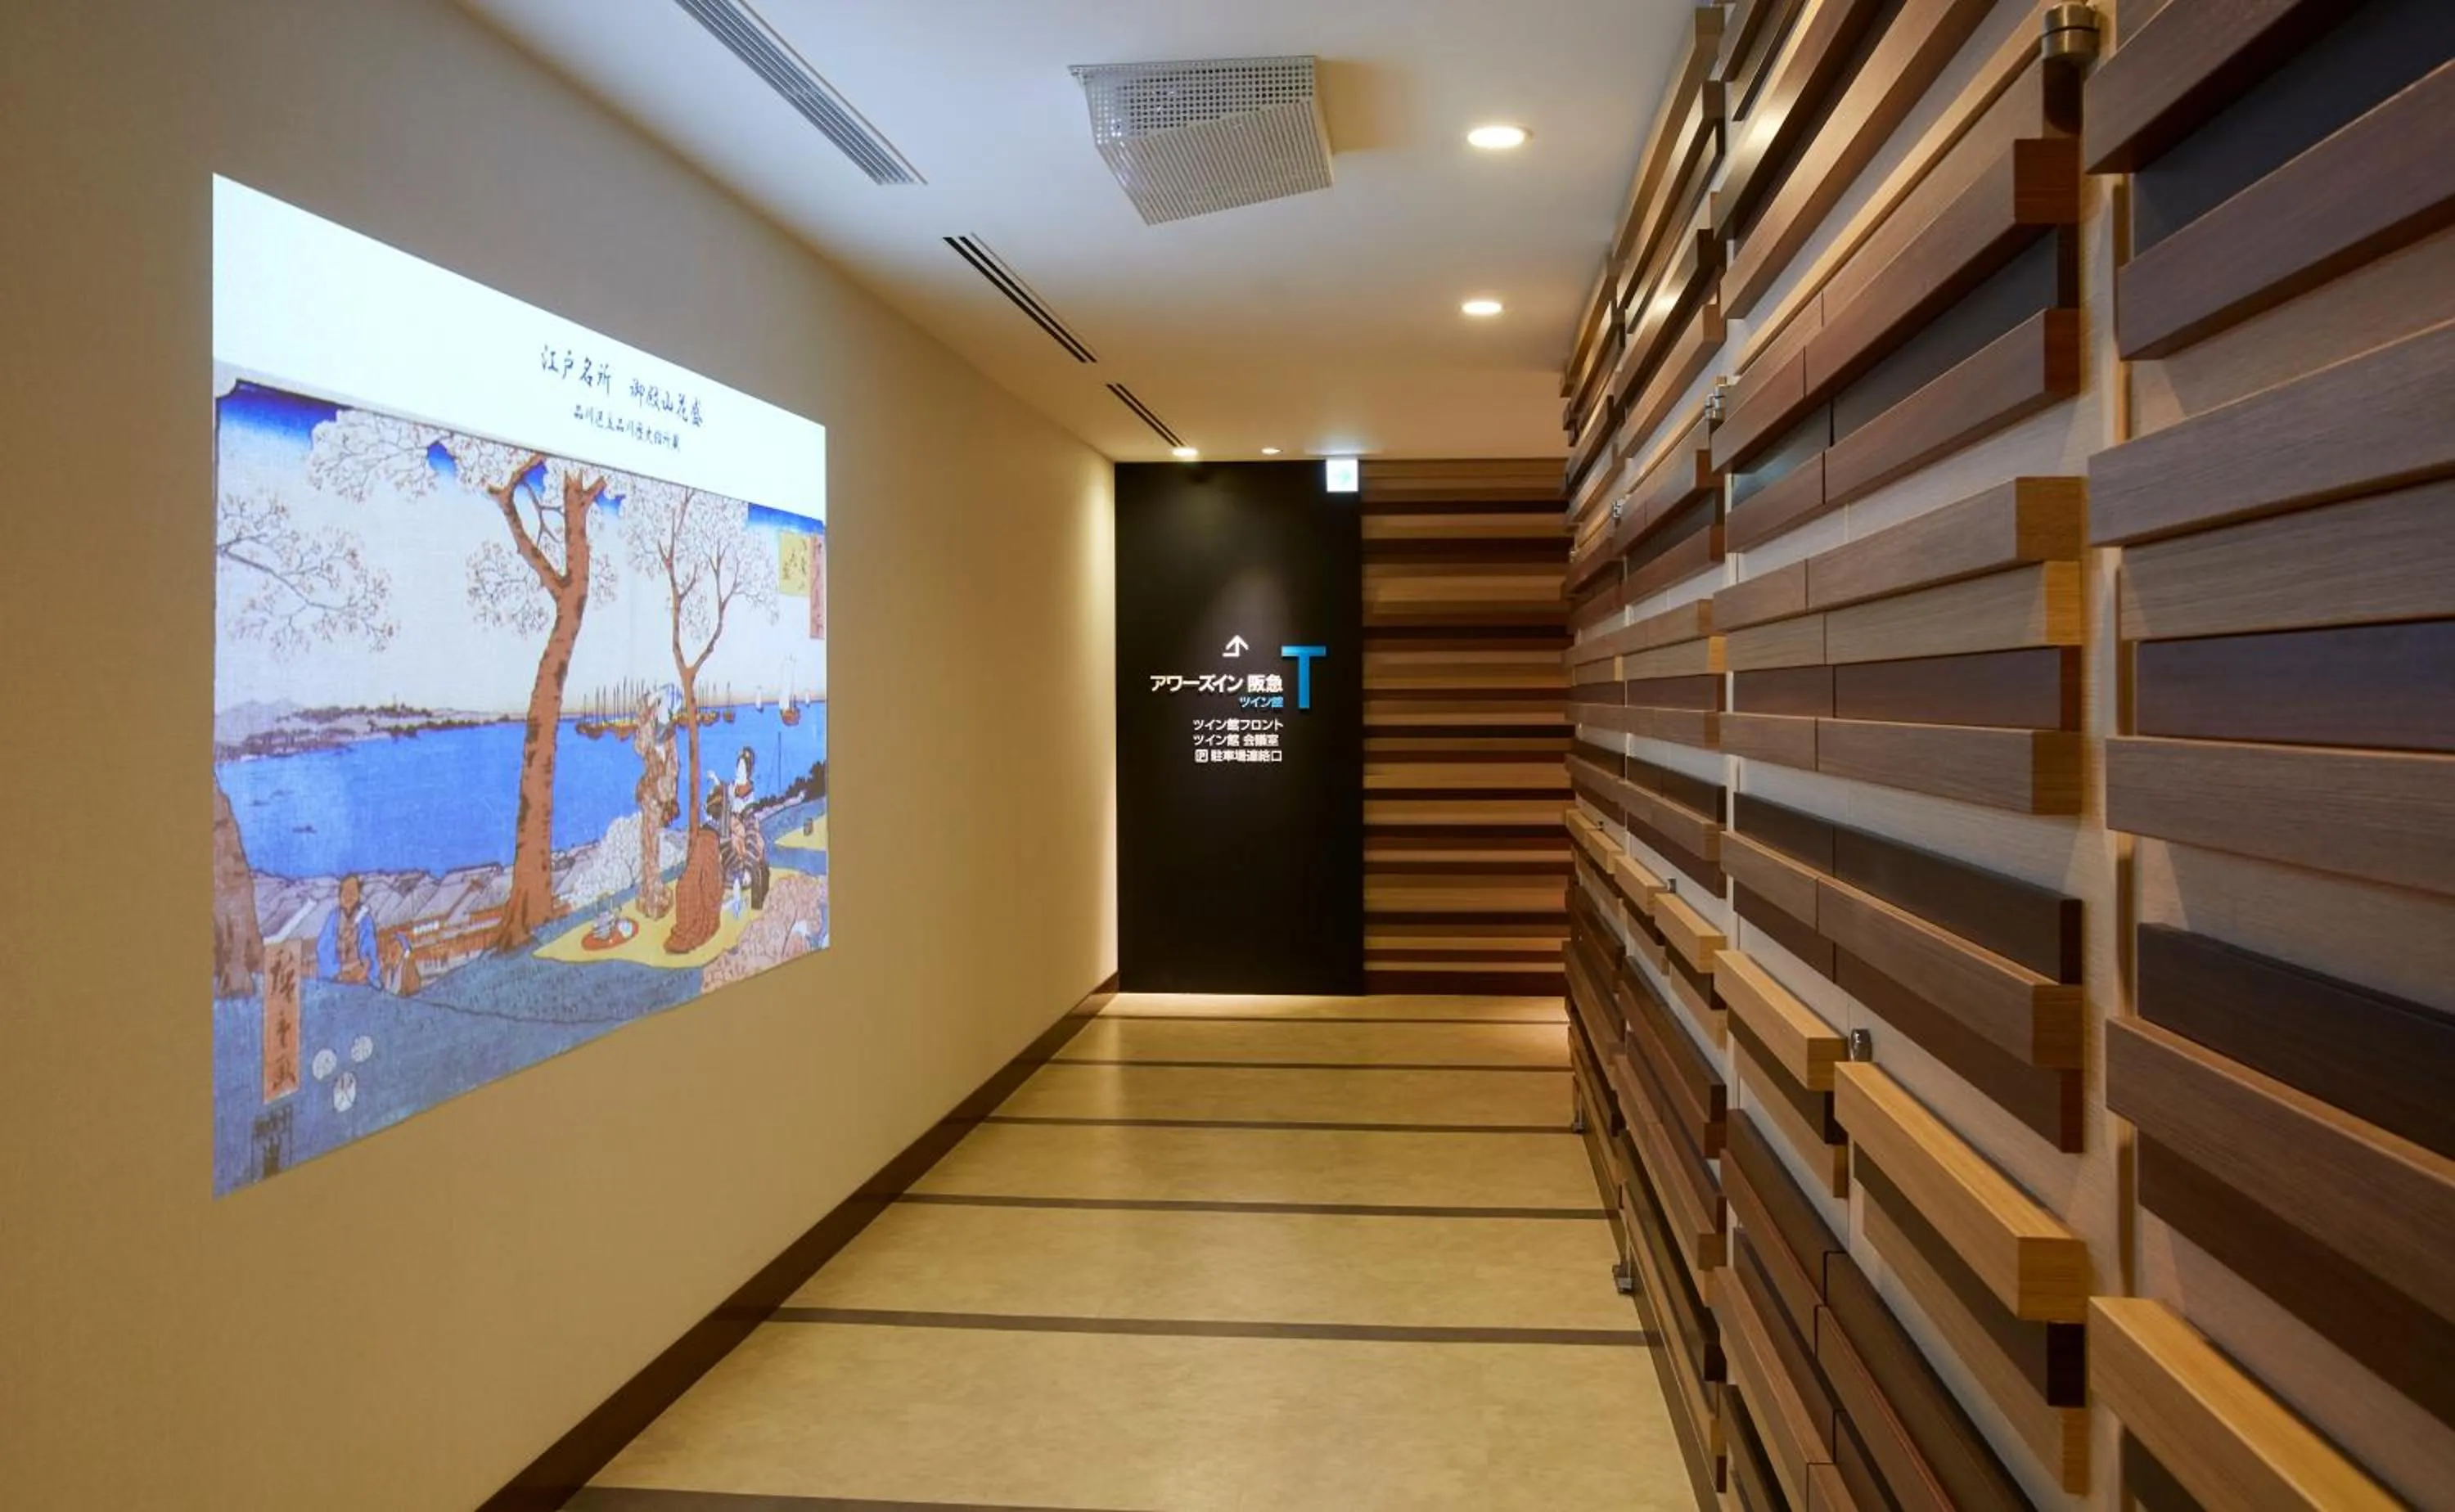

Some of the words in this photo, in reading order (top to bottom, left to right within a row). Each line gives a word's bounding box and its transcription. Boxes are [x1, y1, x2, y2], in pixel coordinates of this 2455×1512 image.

[541, 344, 612, 396] 江戸名所
[1150, 675, 1243, 693] アワーズイン
[1246, 674, 1283, 693] 阪急
[1281, 646, 1327, 709] T
[1239, 696, 1284, 708] ツイン館
[1193, 718, 1284, 731] ツイン館フロント
[1193, 734, 1240, 746] ツイン館
